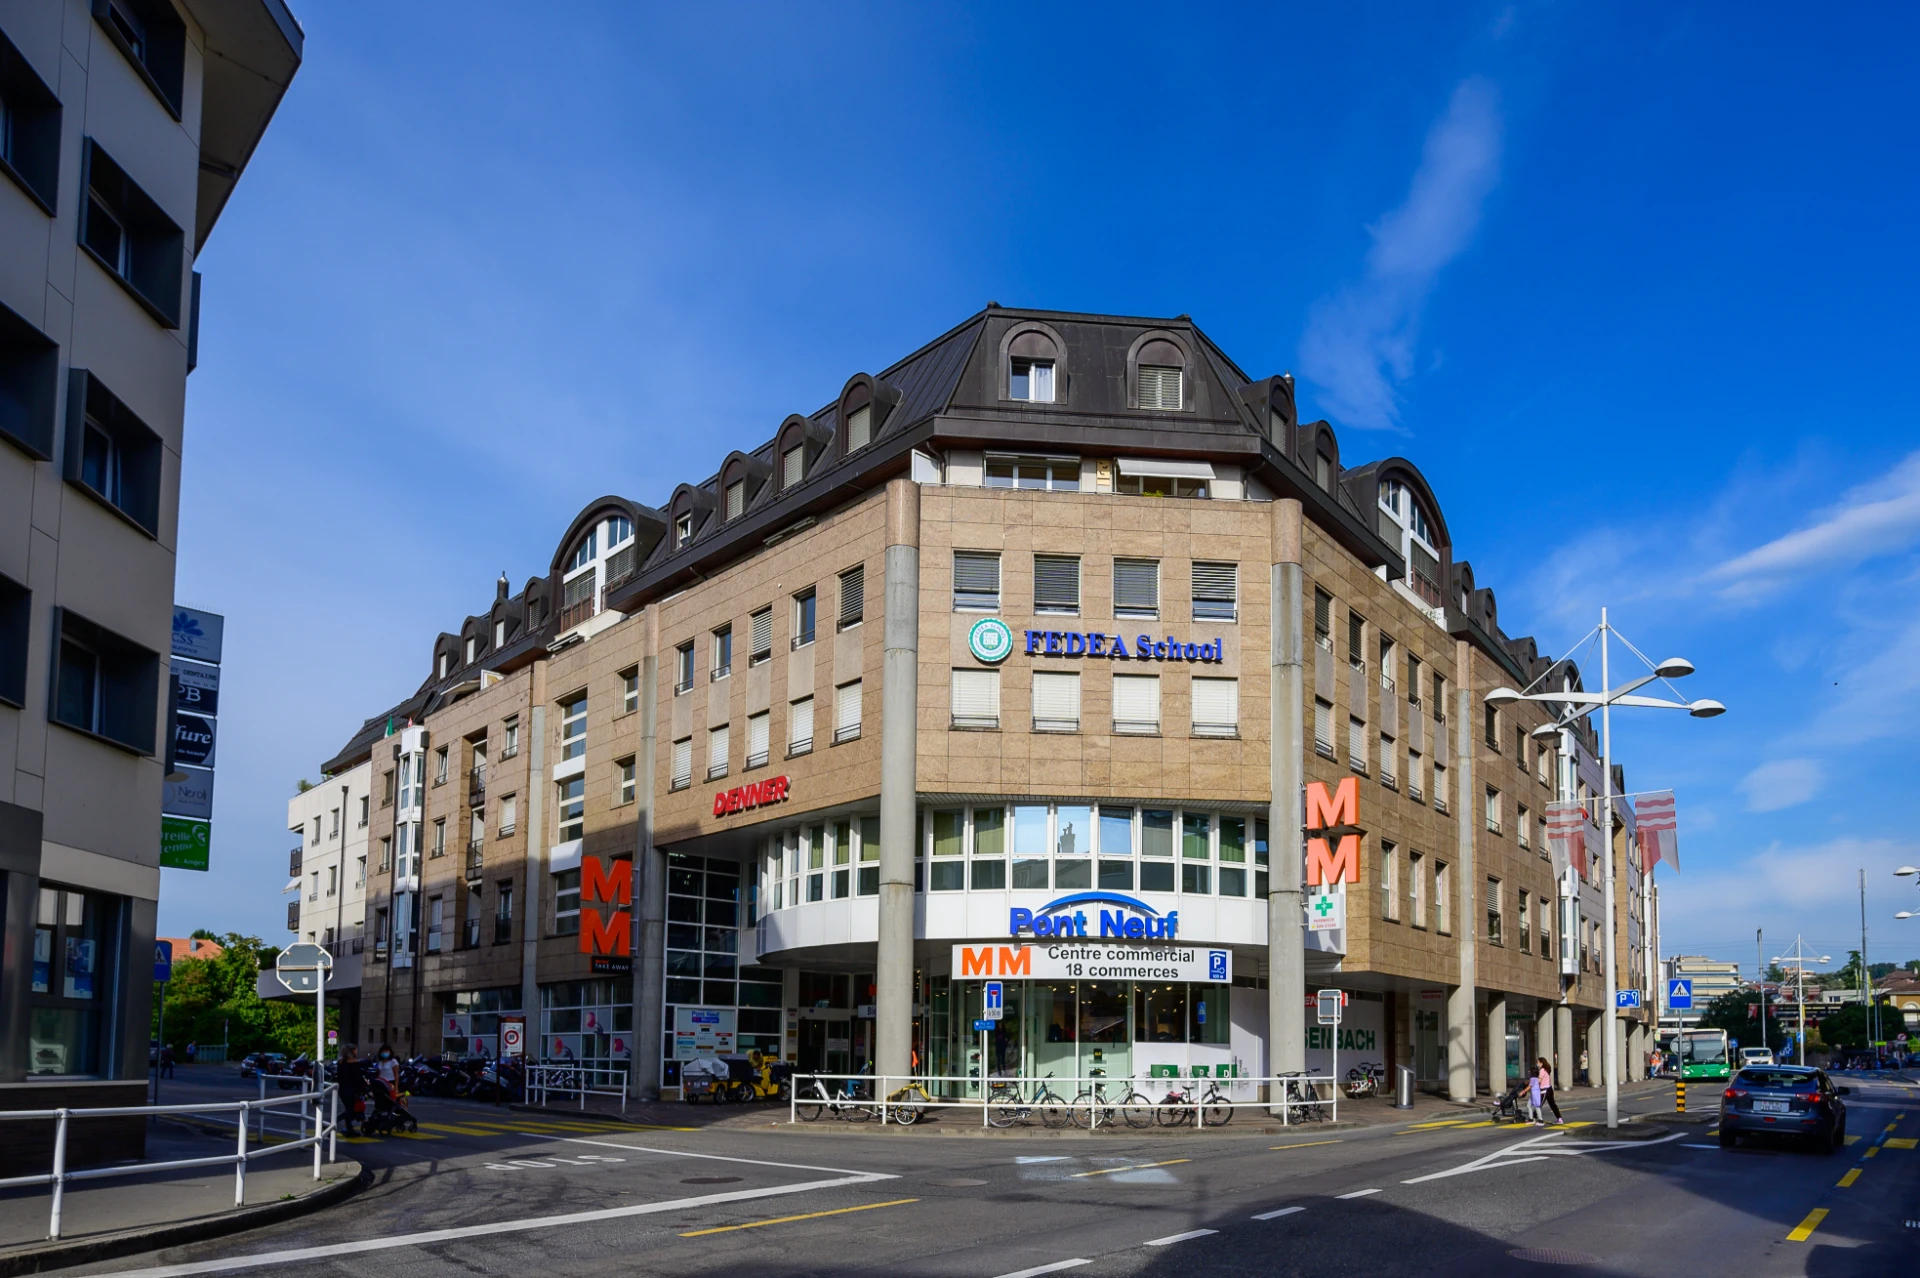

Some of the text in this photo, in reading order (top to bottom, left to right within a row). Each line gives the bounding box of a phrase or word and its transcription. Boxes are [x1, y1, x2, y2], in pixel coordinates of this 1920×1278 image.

[172, 632, 194, 646] CSS
[1024, 630, 1223, 661] FEDEA School
[713, 775, 790, 815] DENNER
[1010, 907, 1179, 938] Pont Neuf
[1048, 946, 1195, 963] Centre commercial
[1213, 956, 1222, 969] P
[1065, 963, 1179, 979] 18 commerces
[1620, 994, 1627, 1004] P
